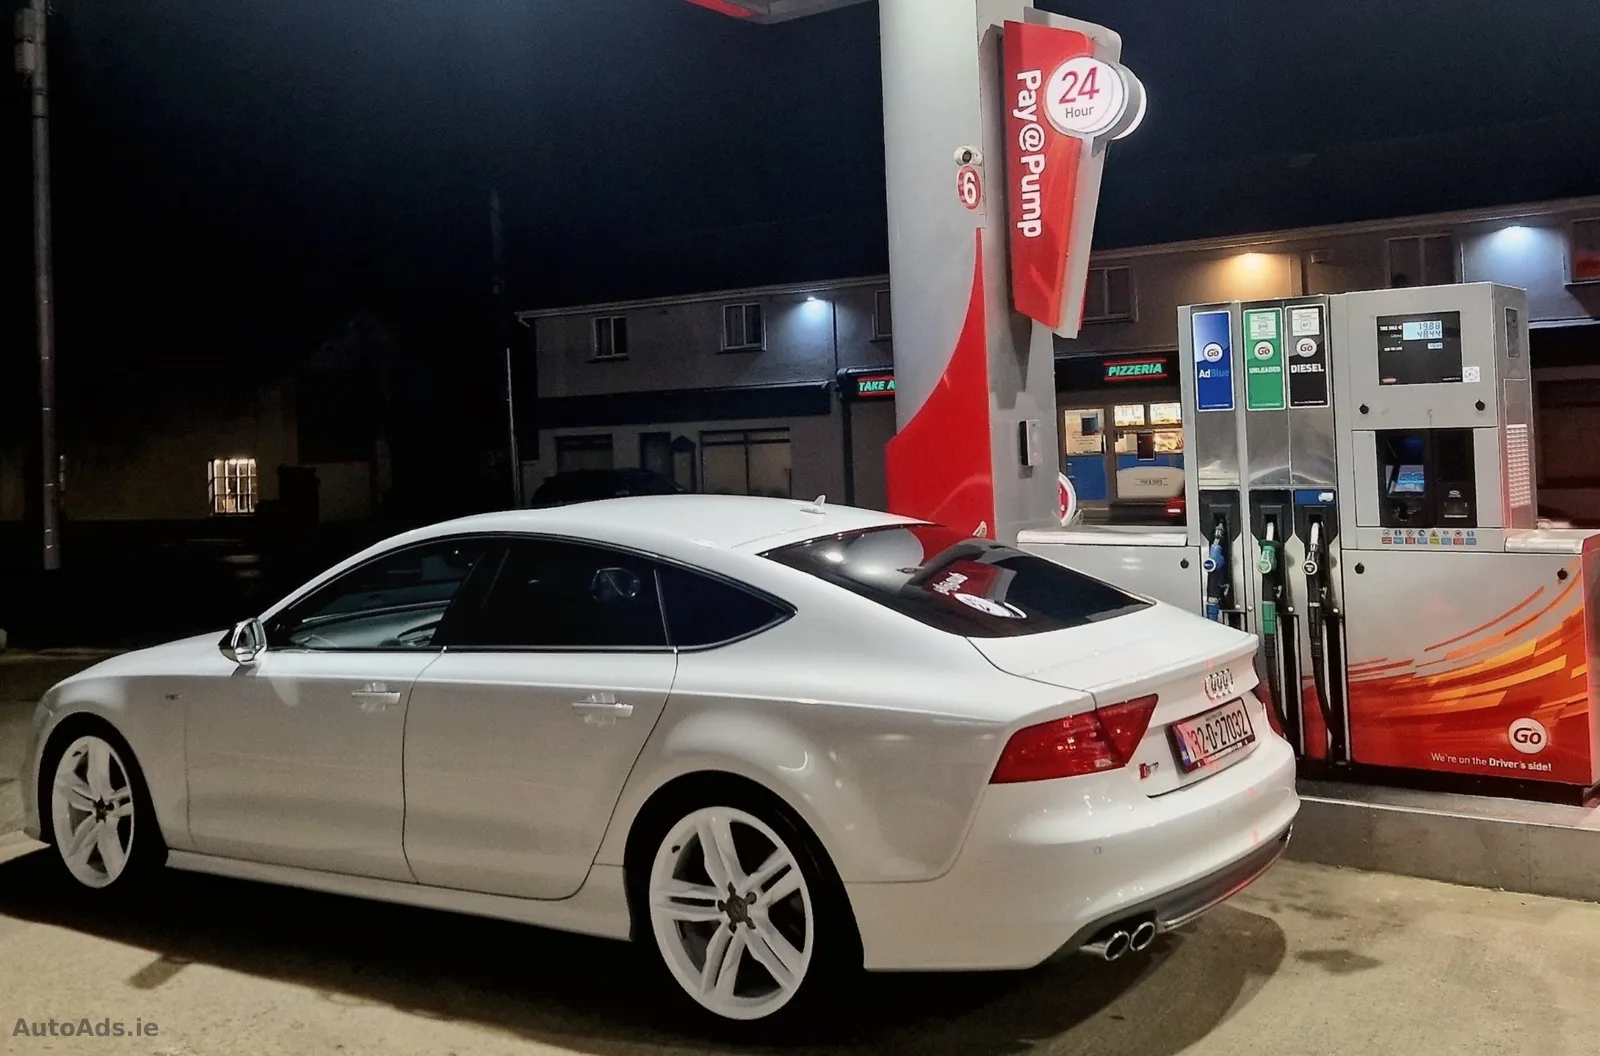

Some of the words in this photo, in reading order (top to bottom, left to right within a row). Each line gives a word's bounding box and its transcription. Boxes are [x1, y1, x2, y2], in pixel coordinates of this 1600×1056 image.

[1058, 66, 1100, 105] 24
[1065, 105, 1095, 119] Hour
[1013, 69, 1046, 239] Pay@Pump
[962, 171, 978, 205] 6
[1108, 362, 1164, 377] PIZZERIA
[1199, 368, 1230, 379] AdBlue
[1249, 366, 1282, 374] UNLEADED
[1291, 363, 1325, 374] DIESEL
[859, 380, 885, 391] TAKE
[887, 379, 897, 390] A
[1430, 752, 1457, 763] We're
[1458, 755, 1470, 764] on
[1472, 756, 1487, 765] the
[1489, 758, 1526, 769] Driver's
[1527, 761, 1553, 772] side!
